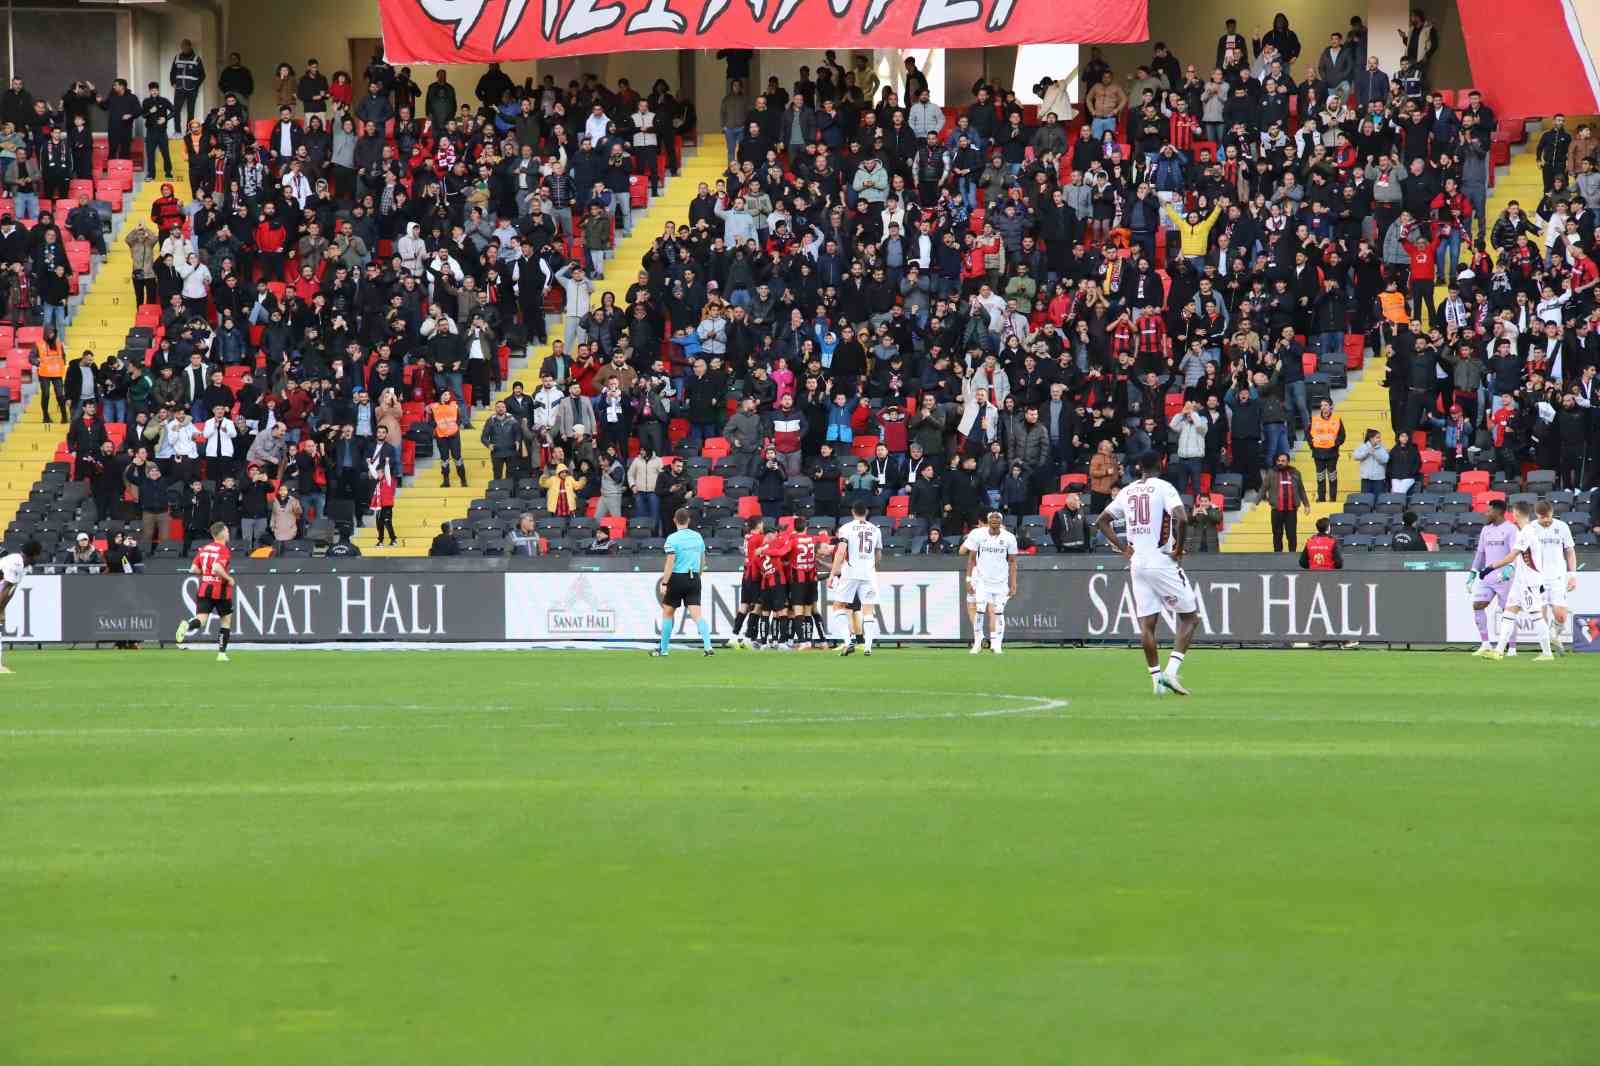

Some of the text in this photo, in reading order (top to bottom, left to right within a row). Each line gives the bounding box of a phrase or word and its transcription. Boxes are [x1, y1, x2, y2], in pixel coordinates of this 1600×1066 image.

[1128, 493, 1151, 526] 30
[796, 543, 815, 563] 23
[858, 531, 873, 554] 15
[199, 552, 220, 575] 77
[338, 575, 446, 635] HALI
[1259, 574, 1381, 637] HALI
[97, 615, 153, 630] SANAT HALI
[553, 614, 610, 629] SANAT HALI
[1004, 613, 1057, 628] ANAT HALI
